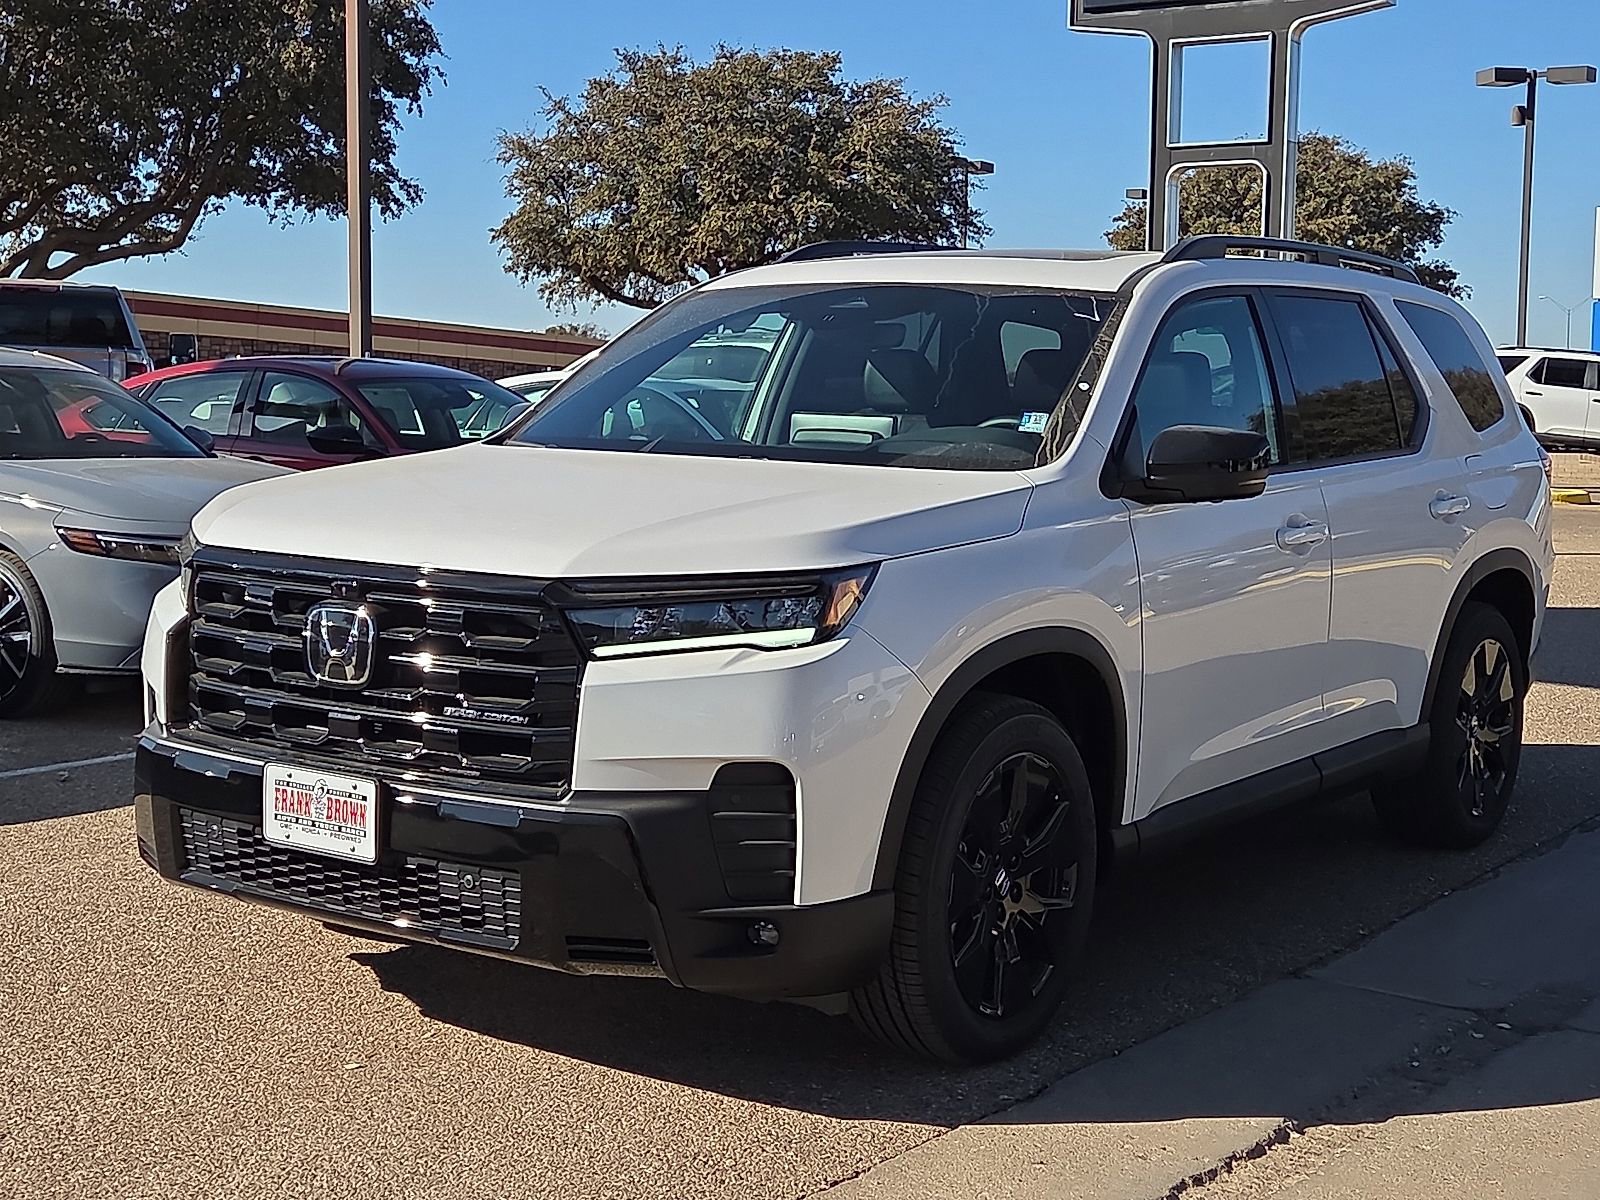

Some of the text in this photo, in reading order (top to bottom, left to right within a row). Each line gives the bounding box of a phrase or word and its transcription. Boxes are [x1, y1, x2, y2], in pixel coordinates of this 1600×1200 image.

[274, 788, 367, 828] FRANK BROWN
[276, 814, 366, 837] AUTO AND TRUCK RANCH
